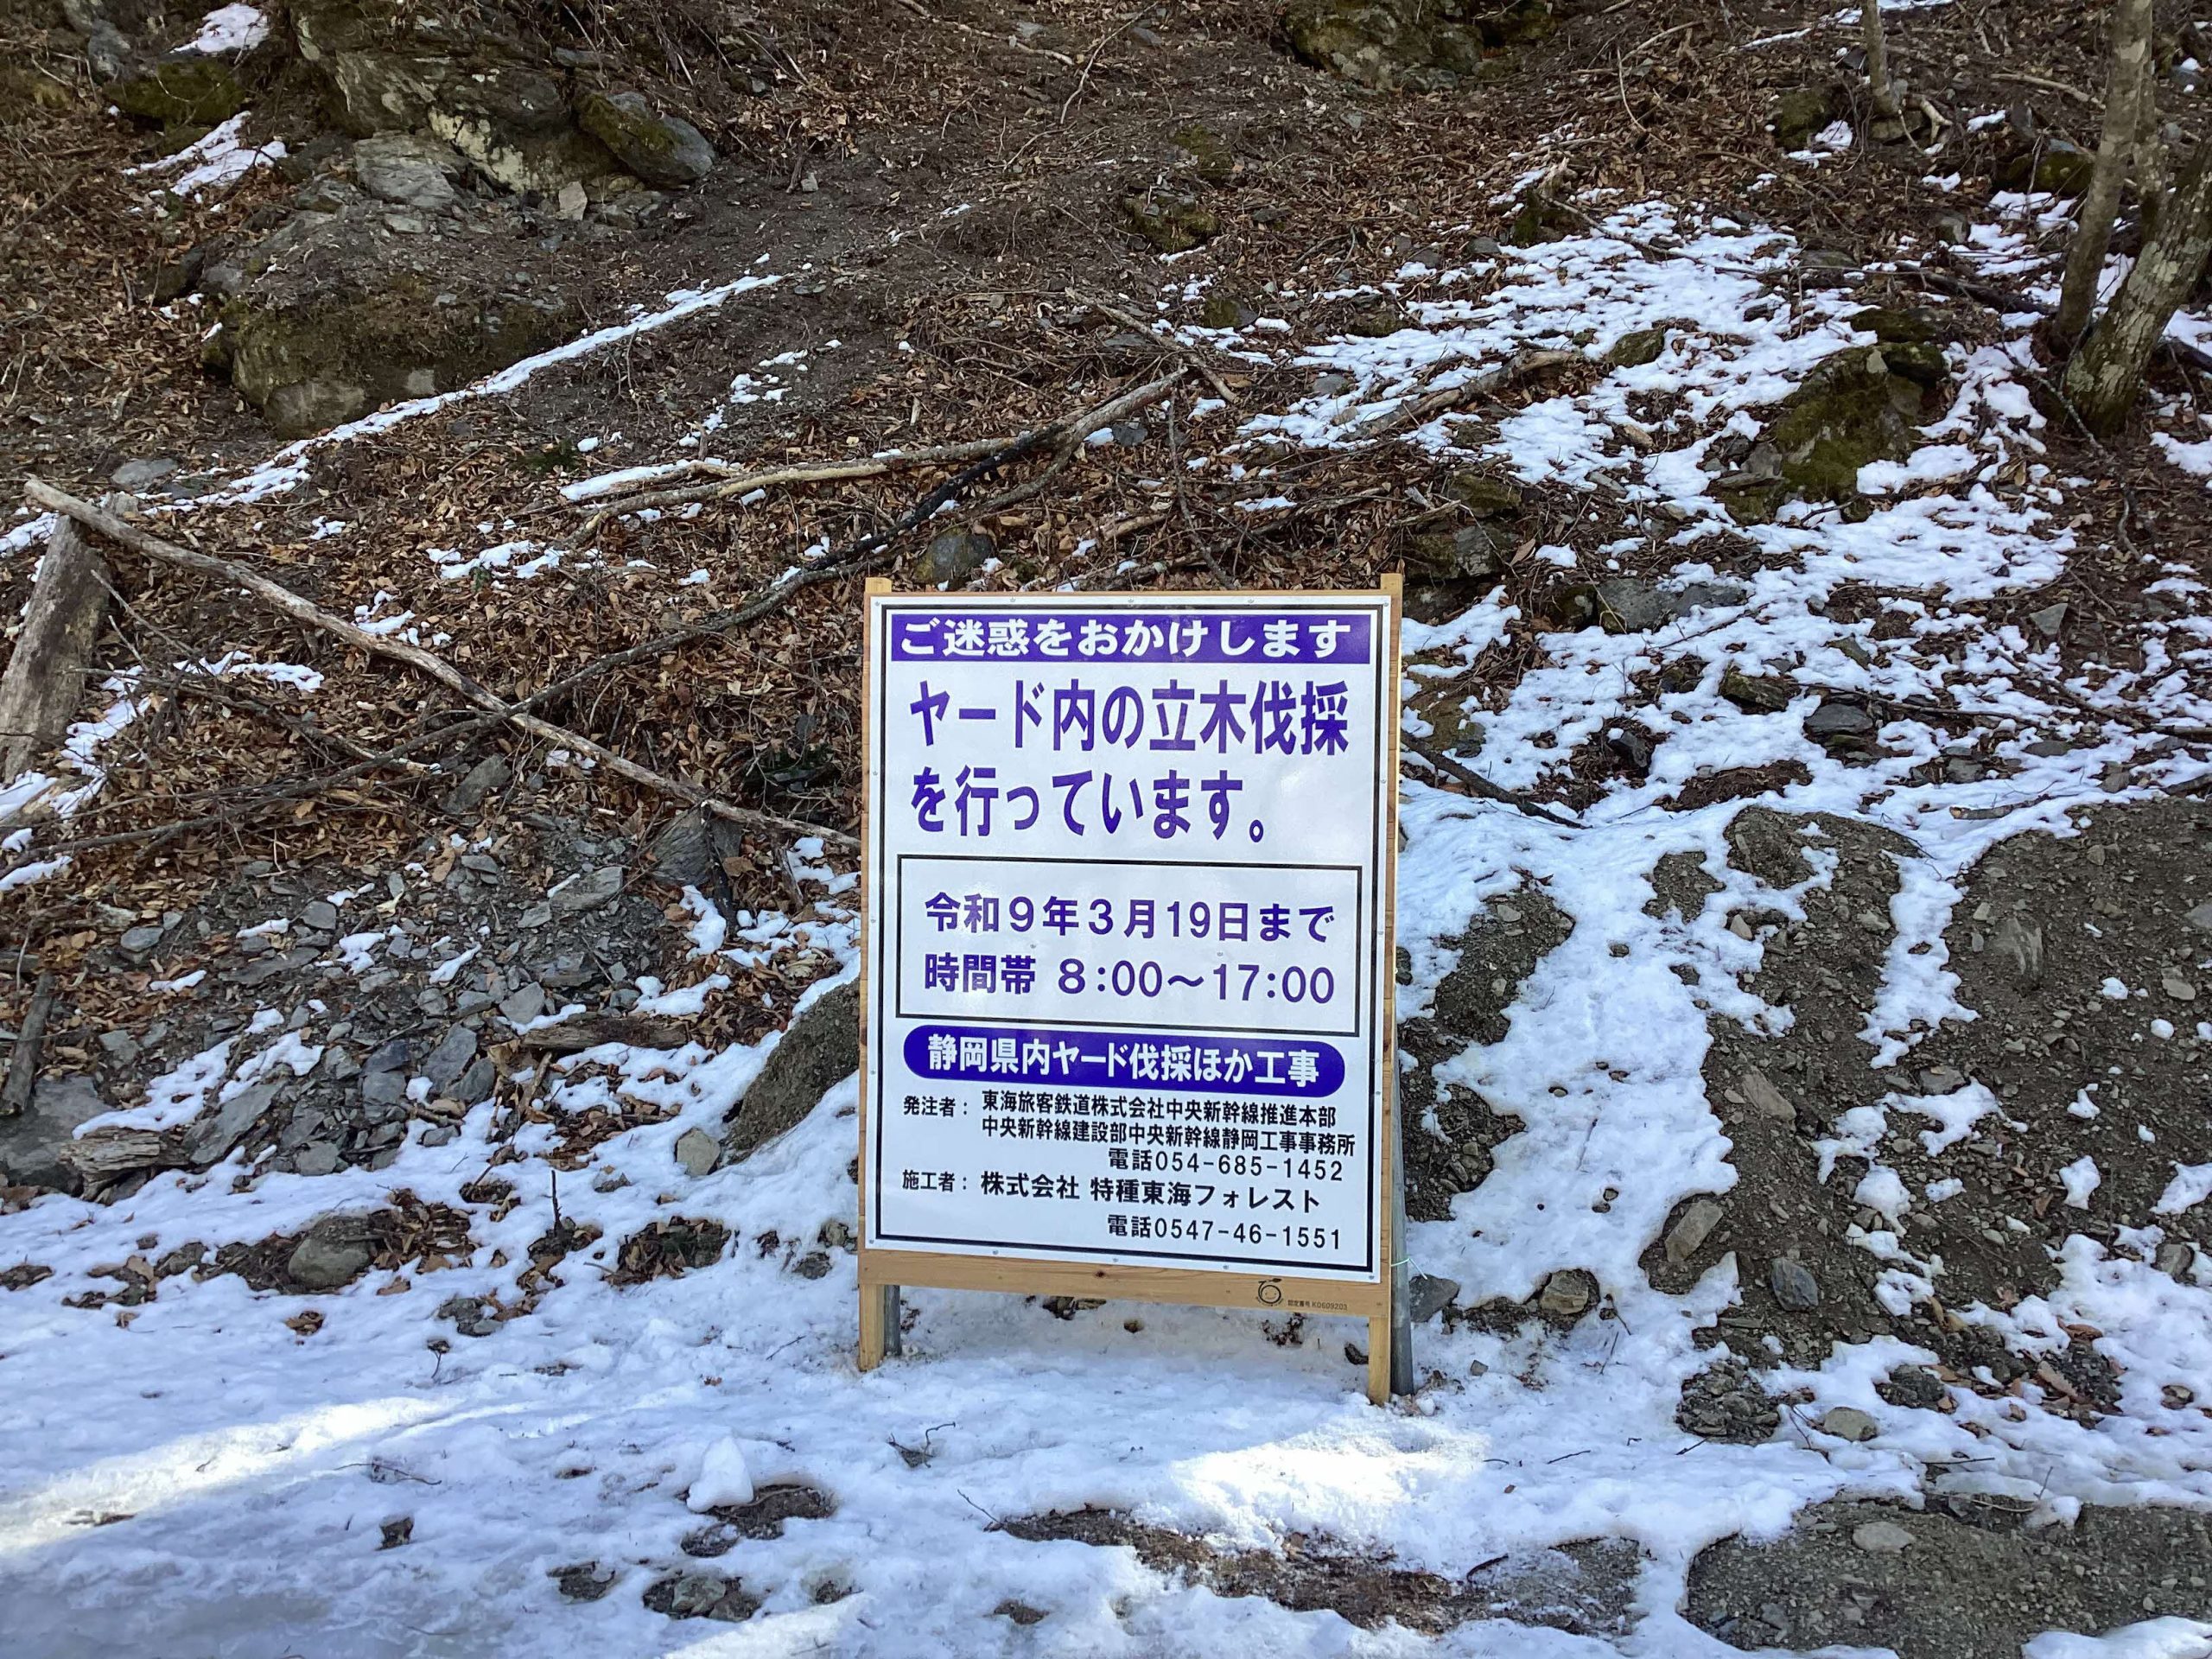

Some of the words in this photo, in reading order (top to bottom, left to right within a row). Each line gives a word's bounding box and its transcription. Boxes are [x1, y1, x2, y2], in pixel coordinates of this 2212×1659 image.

[902, 618, 1351, 658] ご迷惑をおかけします
[911, 679, 1348, 755] ヤード内の立木伐採
[912, 766, 1263, 842] を行っています。
[925, 893, 1334, 942] 令和9年3月19日まで
[925, 952, 1035, 994] 時間帯
[928, 1034, 1319, 1087] 静岡県内ヤード伐採ほか工事
[982, 1090, 1336, 1128] 東海旅客鉄道株式会社中央新幹線推進本部
[982, 1116, 1355, 1156] 中央新幹線建設部中央新幹線静岡工事事務所
[1109, 1148, 1342, 1181] 電話054-685-1452
[982, 1171, 1079, 1198] 株式会社
[1090, 1177, 1319, 1213] 特種東海フォレスト
[1108, 1215, 1338, 1249] 電話0547-46-1551
